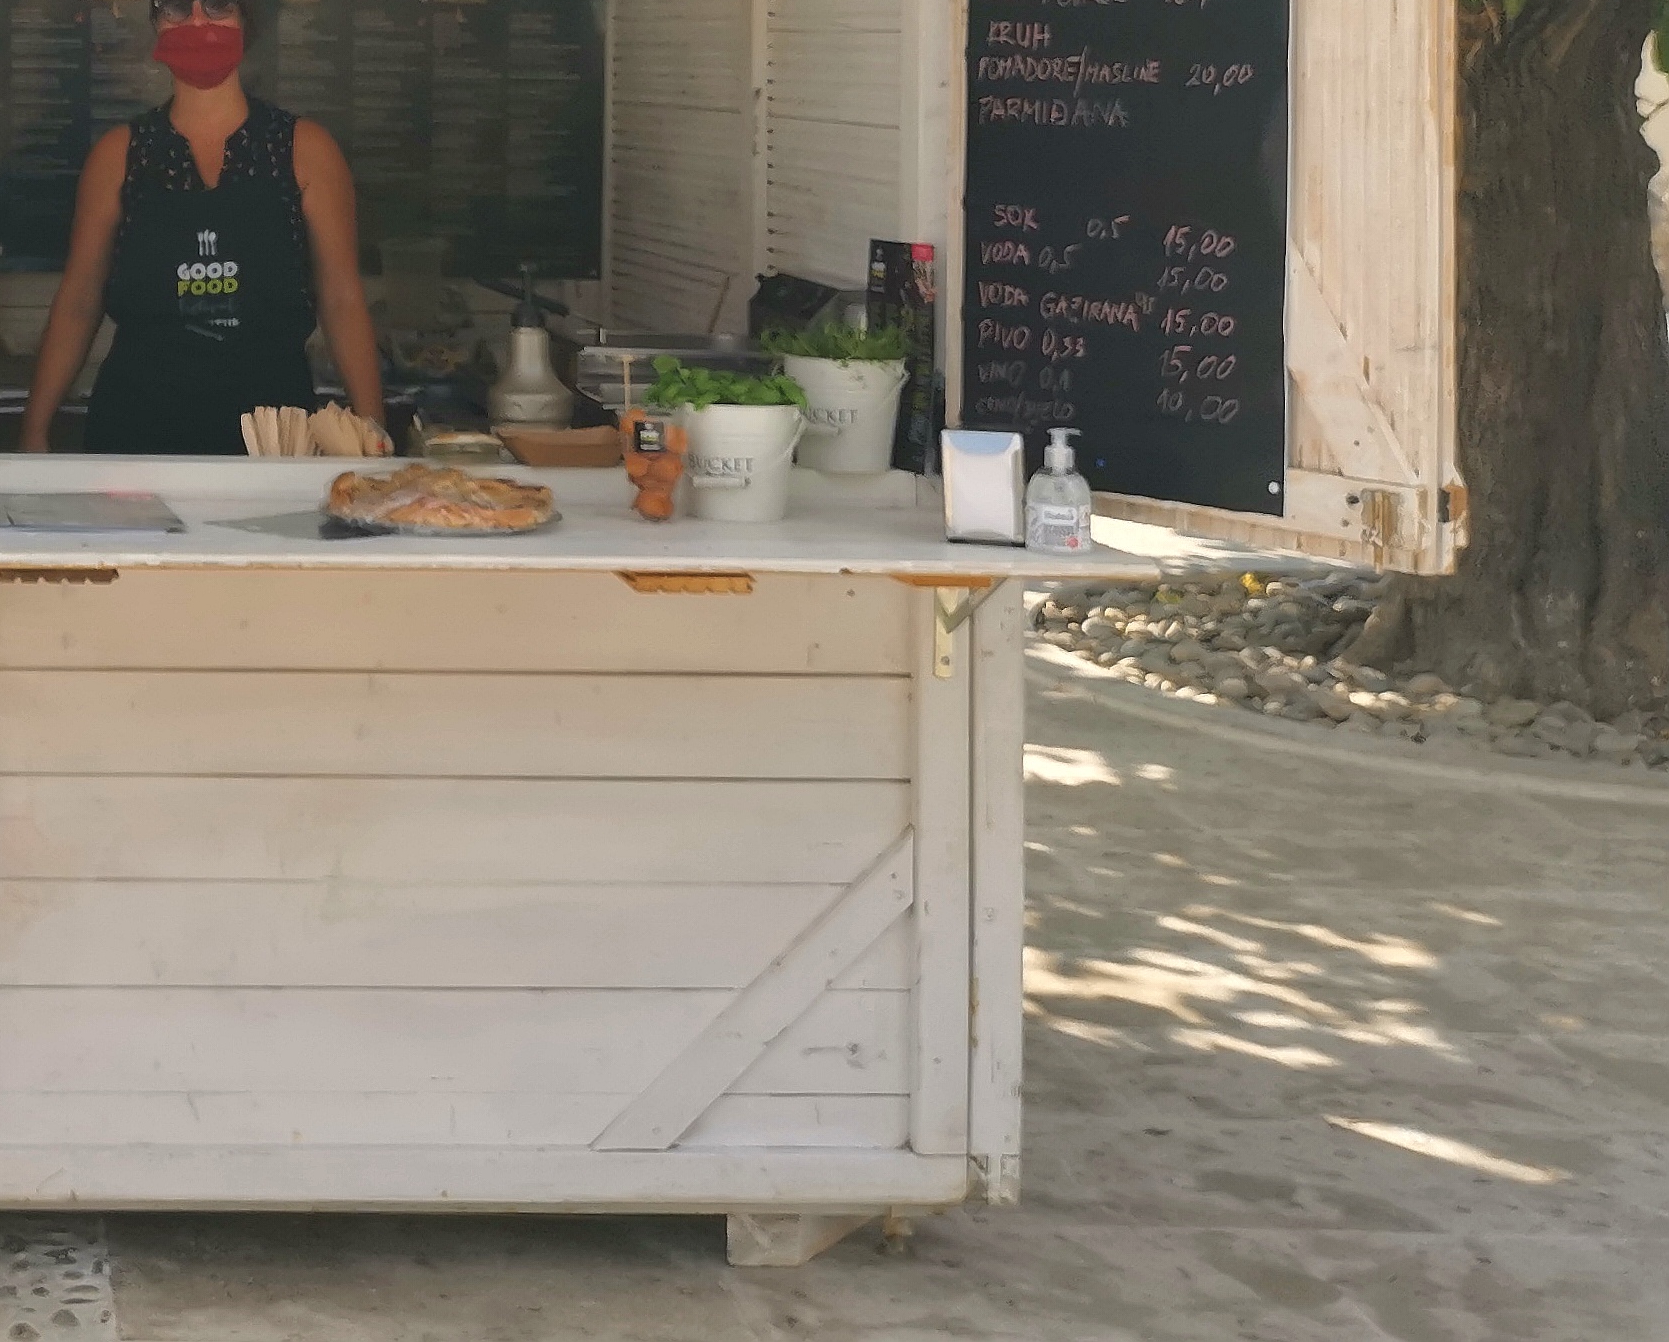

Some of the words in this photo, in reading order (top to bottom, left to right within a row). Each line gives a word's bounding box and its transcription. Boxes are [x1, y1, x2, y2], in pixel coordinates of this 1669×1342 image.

[1184, 63, 1255, 97] 20,00
[993, 203, 1040, 232] SOK
[1162, 225, 1236, 262] 15,00
[177, 261, 239, 280] GOOD
[177, 278, 239, 297] FOOD
[980, 240, 1030, 266] VODA
[1156, 266, 1229, 296] 15,00
[977, 280, 1031, 308] VODA
[1159, 308, 1236, 338] 15,00
[977, 318, 1032, 349] PIVO
[1158, 345, 1237, 384] 15,00
[688, 452, 755, 475] BUCKET
